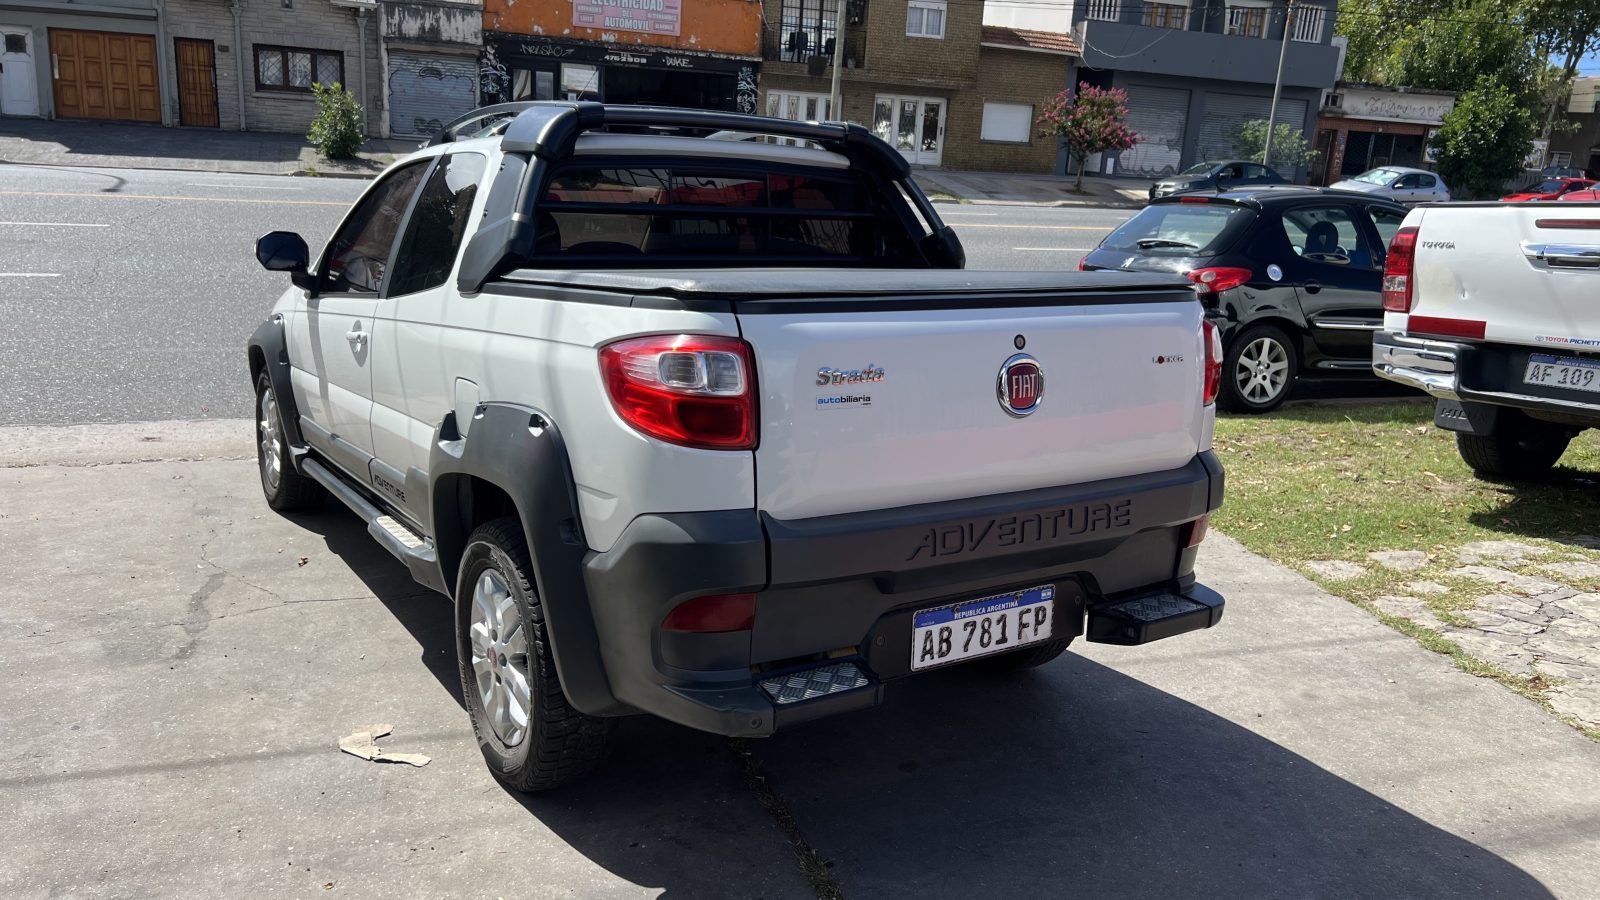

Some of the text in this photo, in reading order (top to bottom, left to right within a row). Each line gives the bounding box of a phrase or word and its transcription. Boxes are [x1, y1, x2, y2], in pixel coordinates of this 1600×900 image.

[604, 16, 650, 31] AUTOMOVIL
[1421, 240, 1456, 251] TOYOTA
[816, 362, 885, 387] Strada
[1529, 364, 1595, 387] AF 109
[1012, 373, 1036, 400] FIAT
[817, 395, 872, 404] autobiliaria
[906, 500, 1132, 561] ADVENTURE
[954, 600, 1019, 620] REPUBLICA ARGENTINA
[919, 605, 1048, 663] AB 781 FP
